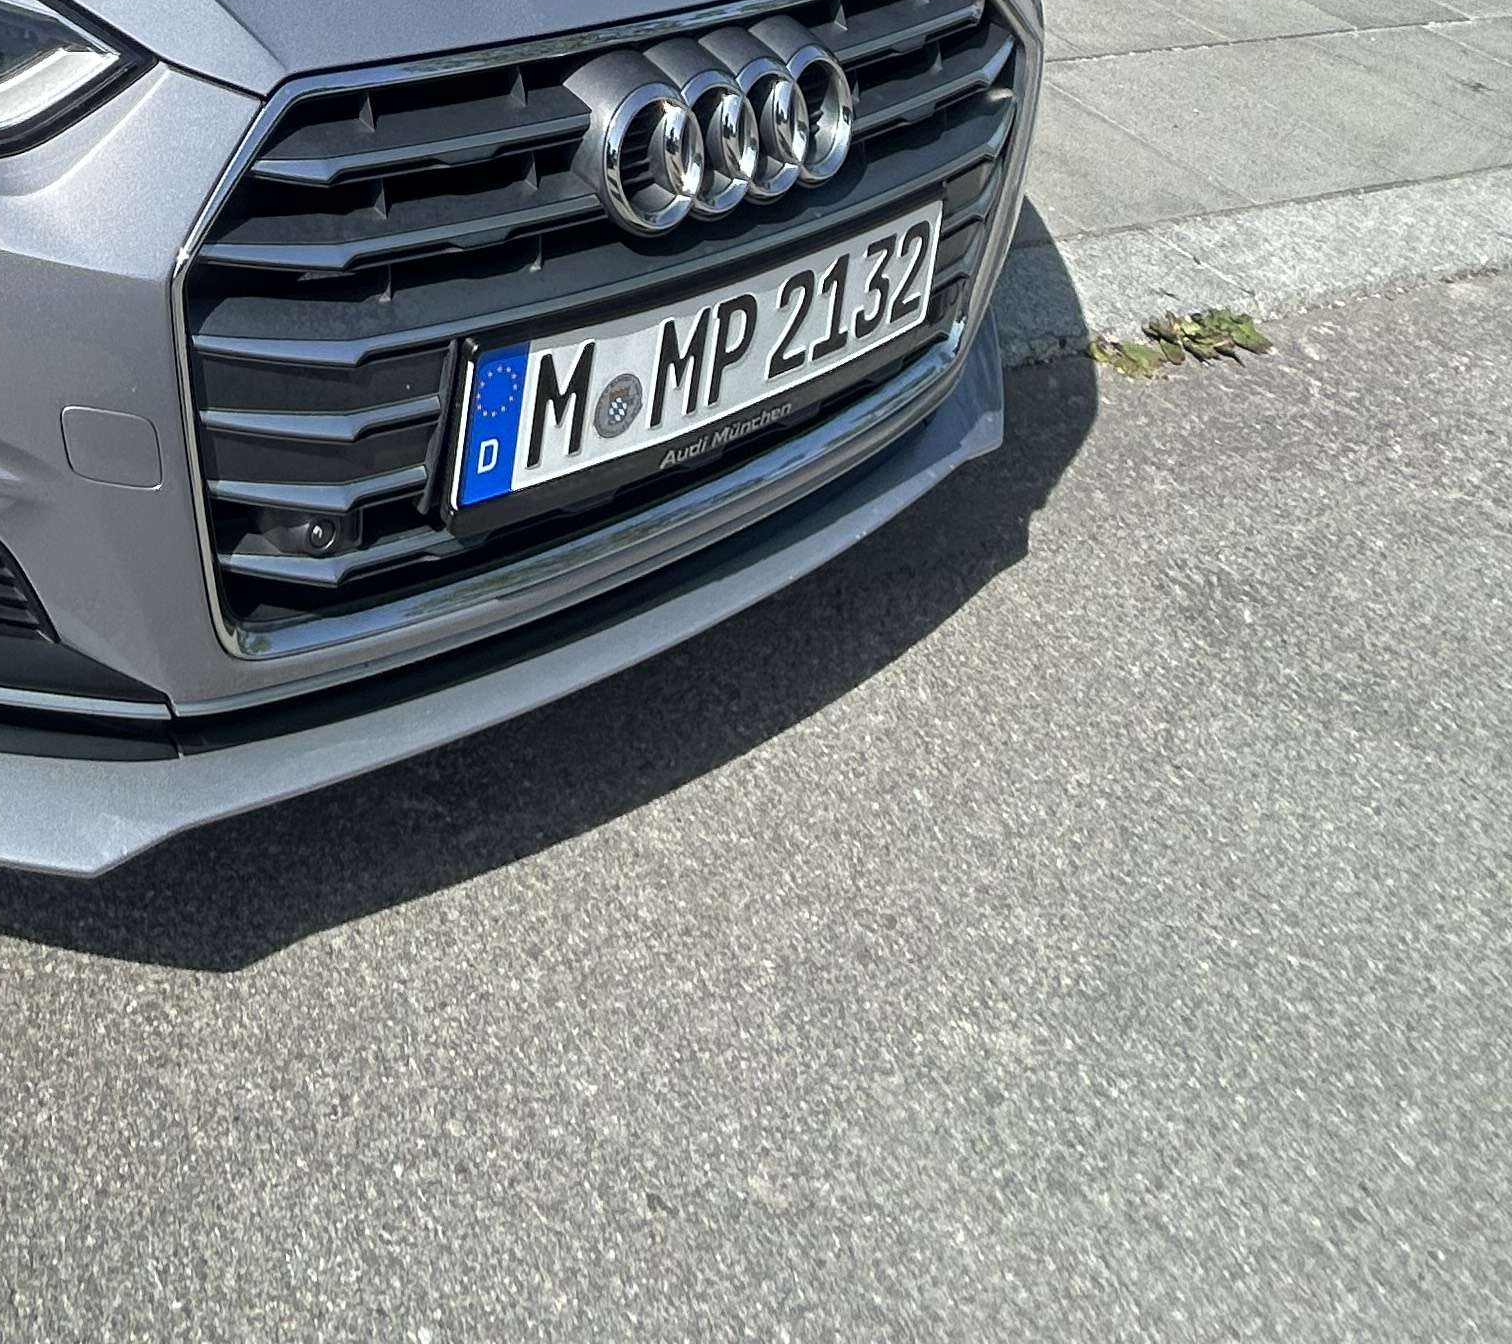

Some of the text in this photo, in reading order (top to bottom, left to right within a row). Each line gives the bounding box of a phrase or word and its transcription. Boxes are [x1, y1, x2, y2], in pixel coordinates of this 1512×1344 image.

[526, 219, 931, 469] M MP 2132
[477, 438, 499, 474] D
[659, 403, 792, 470] Audi München
